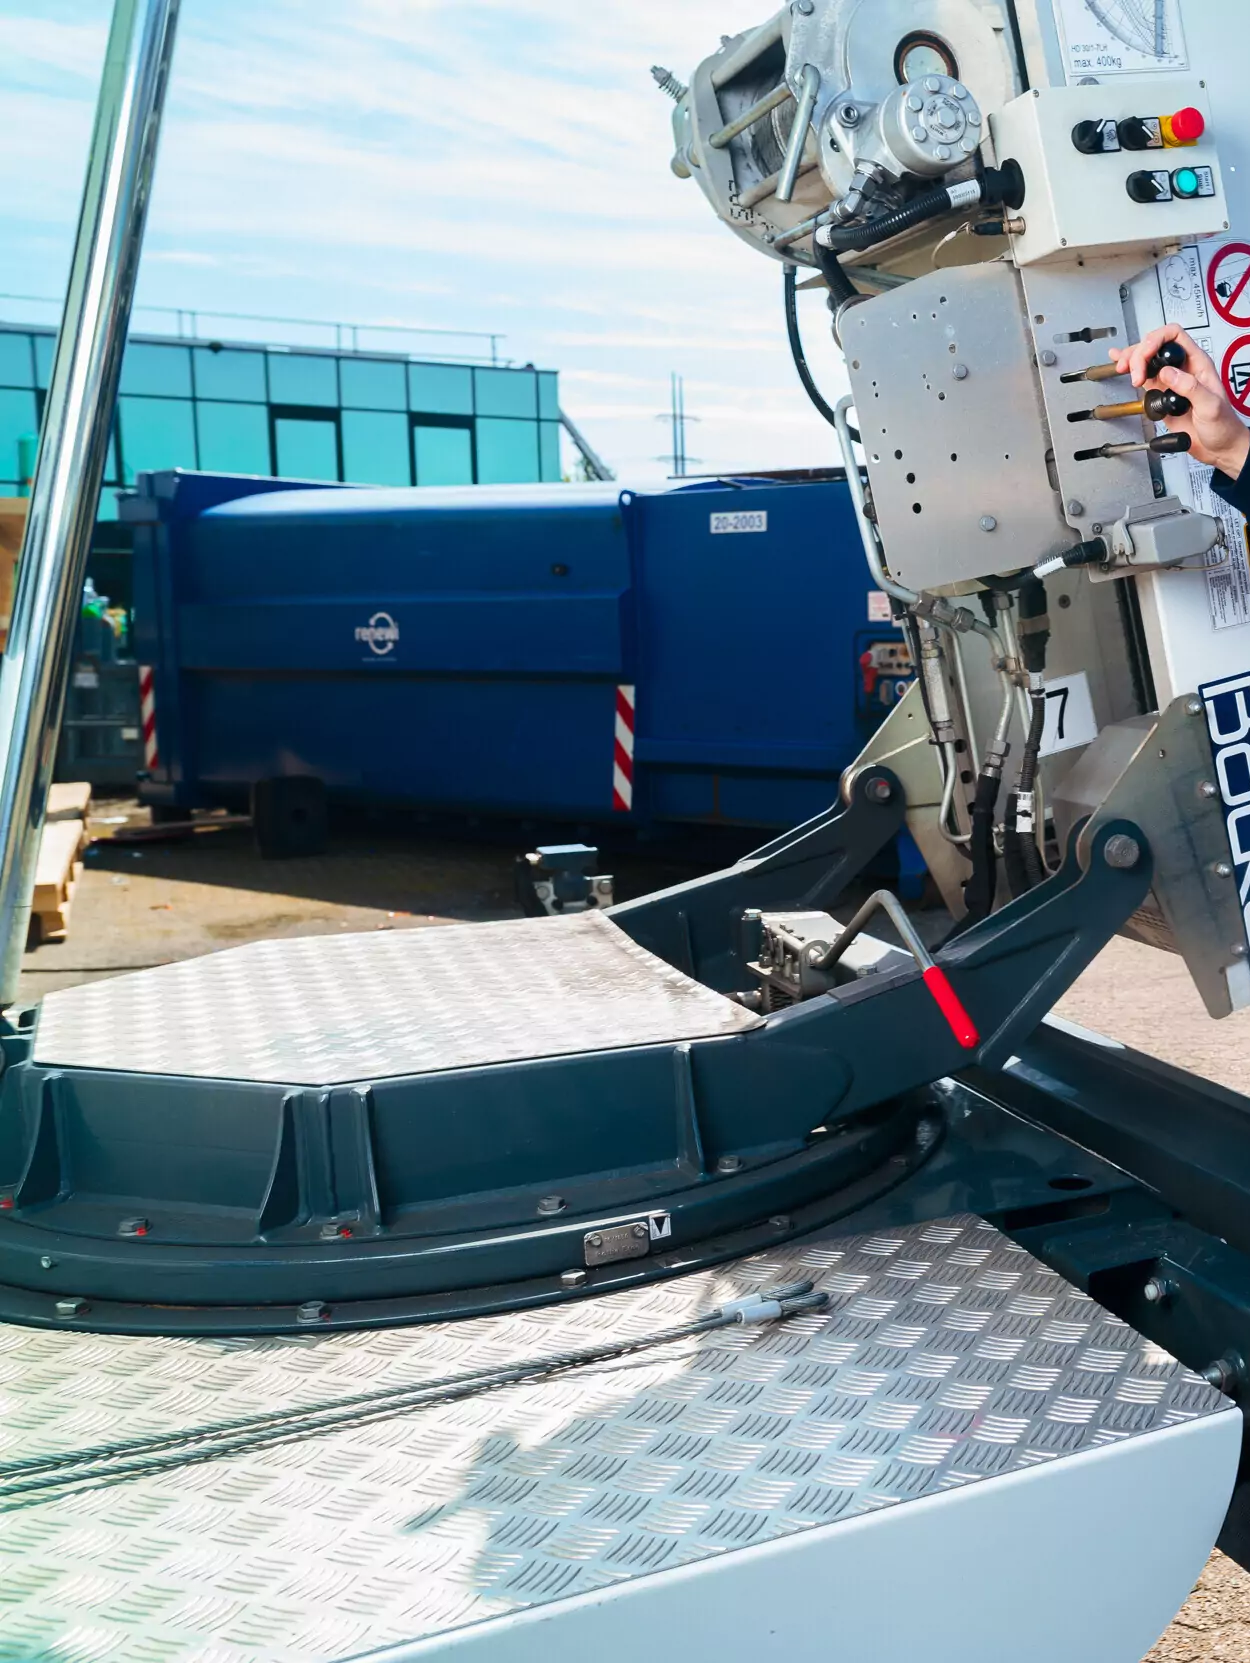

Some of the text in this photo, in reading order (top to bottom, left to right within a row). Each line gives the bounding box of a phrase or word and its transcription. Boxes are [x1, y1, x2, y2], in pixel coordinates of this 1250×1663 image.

[1097, 56, 1122, 69] 400kg
[1194, 283, 1204, 318] 45km/h
[714, 514, 763, 531] 20-2003
[1045, 686, 1069, 740] 7
